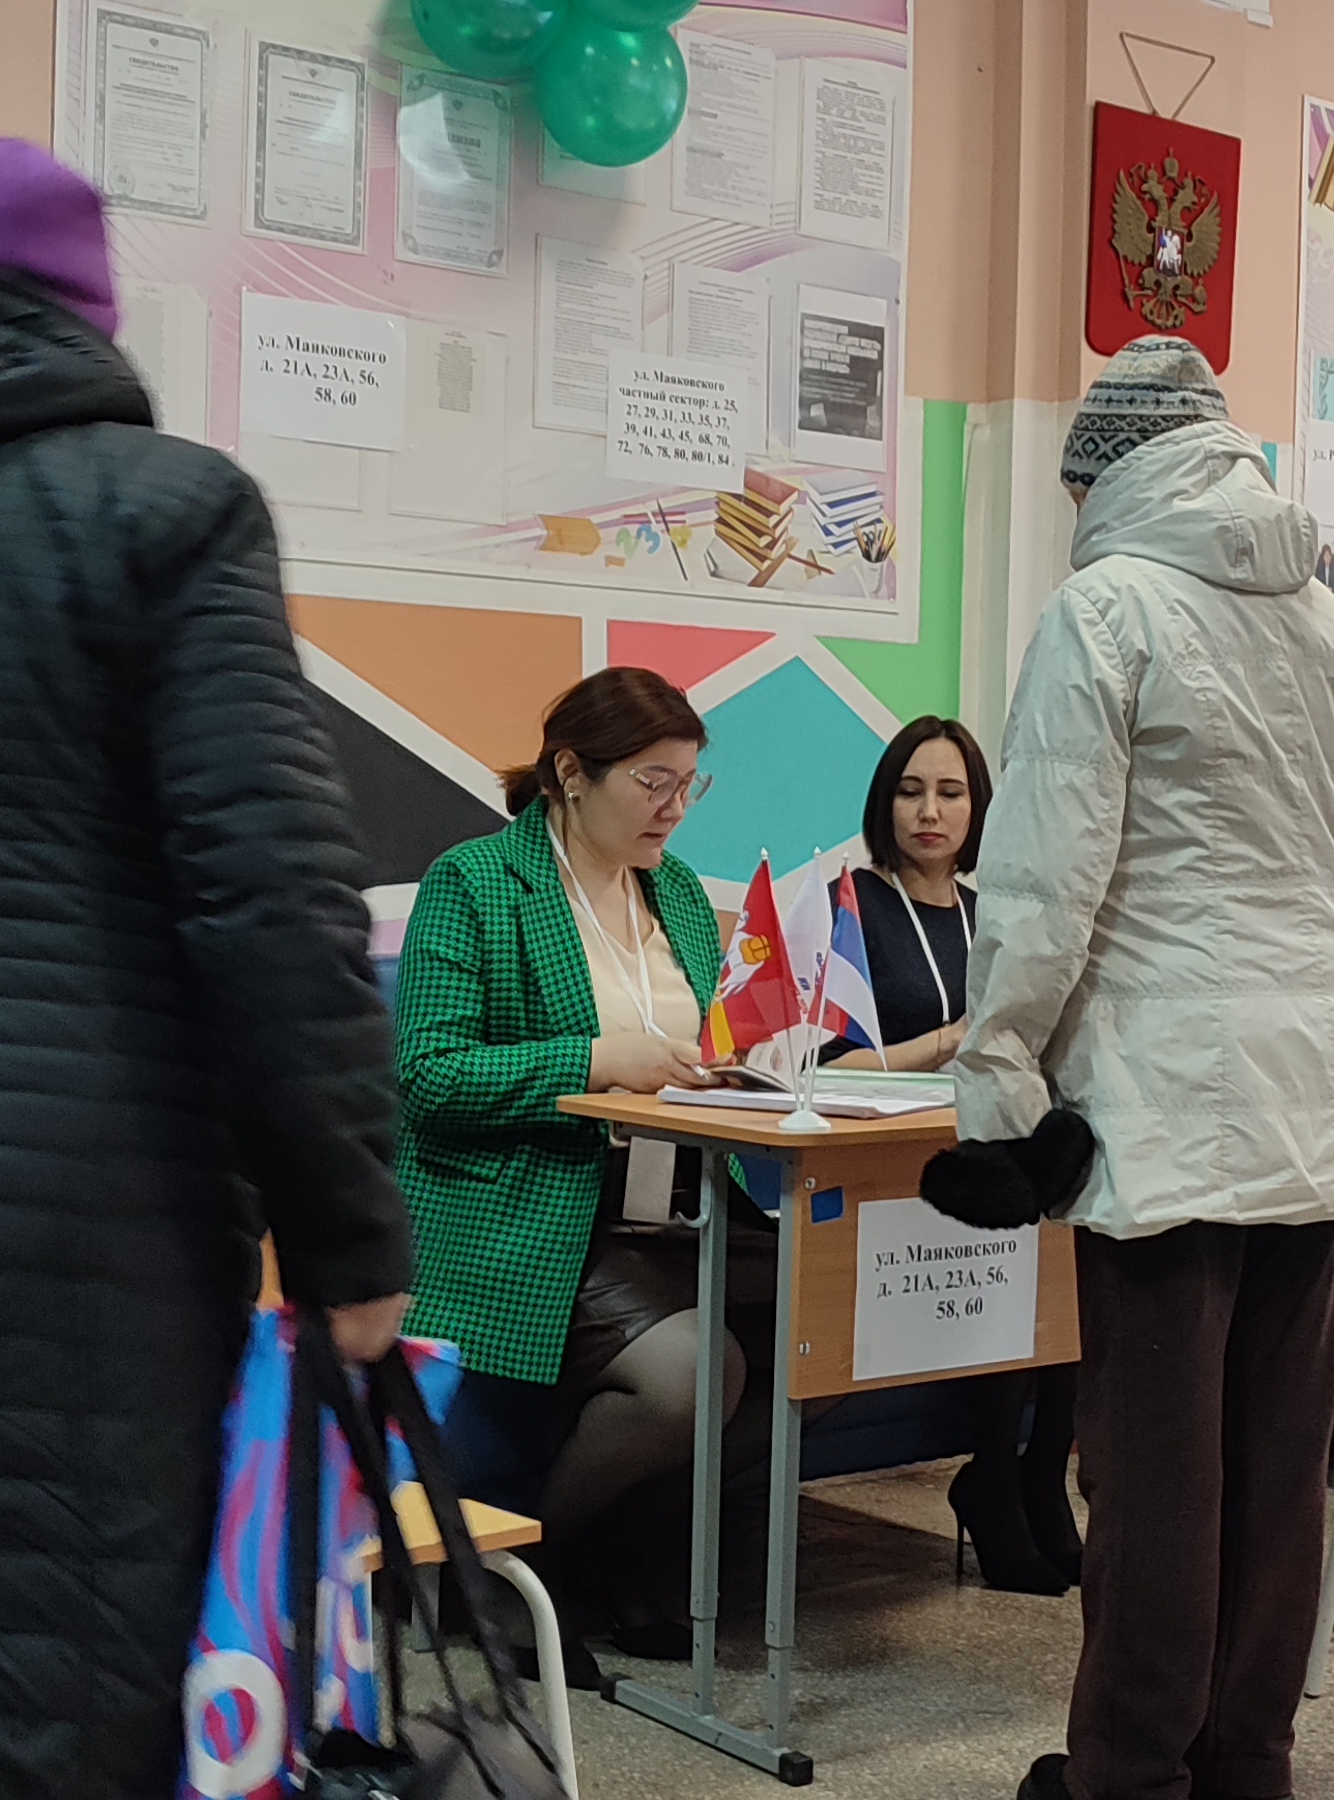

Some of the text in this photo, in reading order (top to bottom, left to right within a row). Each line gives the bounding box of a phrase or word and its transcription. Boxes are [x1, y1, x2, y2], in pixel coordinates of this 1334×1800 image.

[258, 334, 387, 364] ул. Маяковского
[283, 358, 318, 380] 21А,
[322, 363, 356, 386] 23А,
[359, 369, 380, 389] 56,
[633, 370, 725, 392] ул. Маяковского
[314, 386, 357, 407] 58, 60
[619, 386, 666, 402] частный
[669, 394, 709, 410] сектор:
[875, 1239, 1017, 1273] ул. Маяковского
[876, 1264, 1009, 1299] д. 21А, 23А, 56,
[936, 1295, 983, 1320] 58, 60
